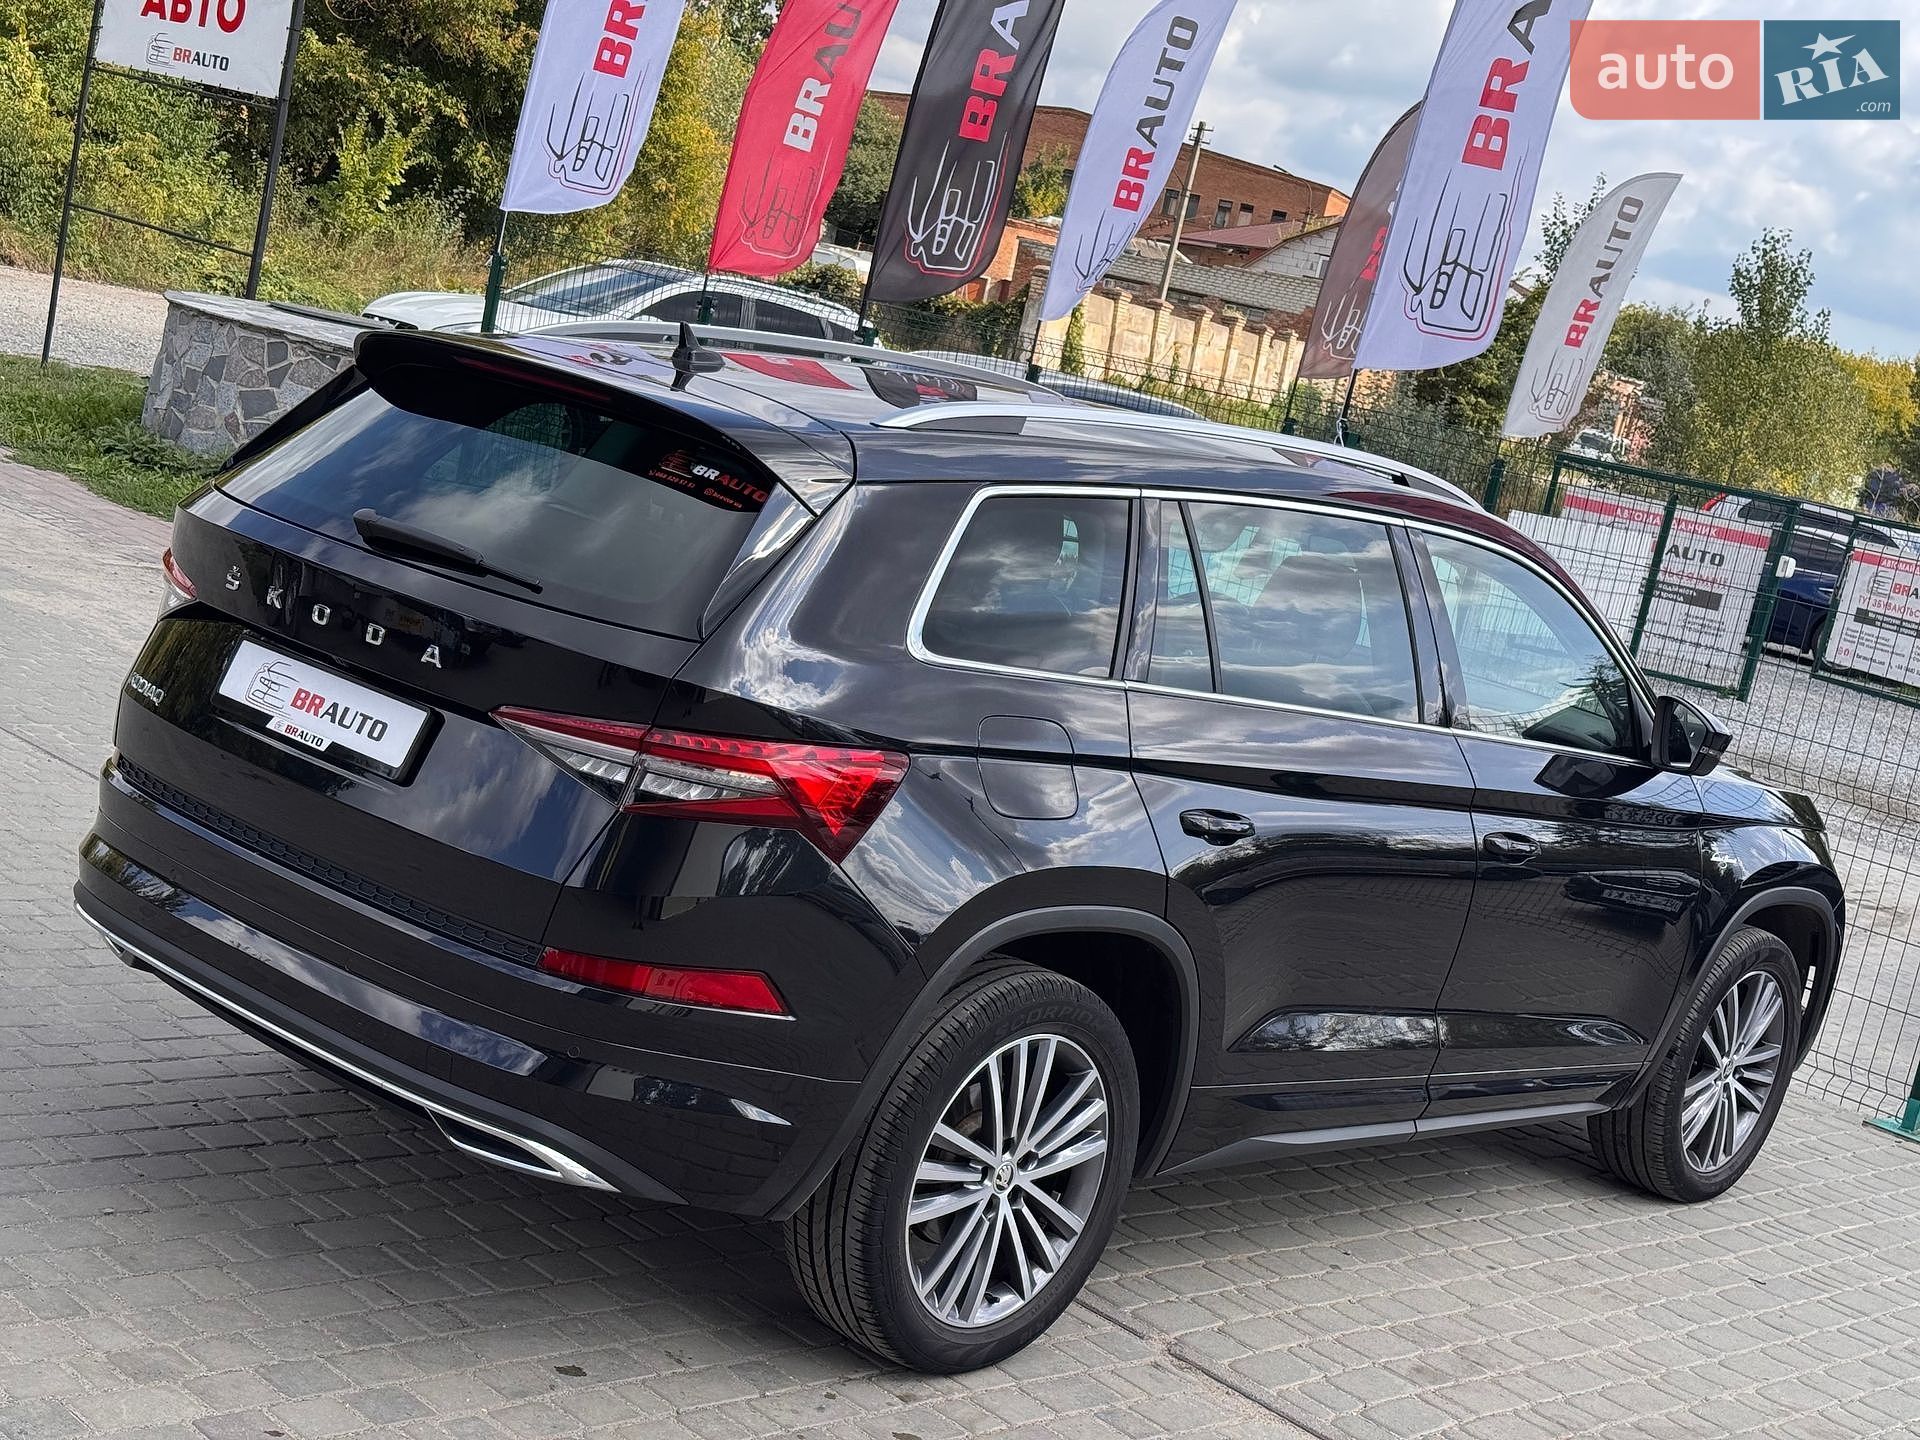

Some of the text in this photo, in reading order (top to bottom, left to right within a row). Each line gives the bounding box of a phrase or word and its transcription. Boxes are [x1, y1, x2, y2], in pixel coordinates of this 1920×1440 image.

[173, 47, 230, 72] BRAUTO
[783, 3, 862, 152] BRAU
[1112, 15, 1199, 213] BRAUTO
[1564, 196, 1644, 348] BRAUTO
[692, 464, 769, 502] BRAUTO
[1616, 505, 1719, 537] АВТОМАДАНЧИК
[225, 565, 442, 669] ŠKODA
[284, 724, 324, 747] BRAUTO
[290, 687, 389, 742] BRAUTO
